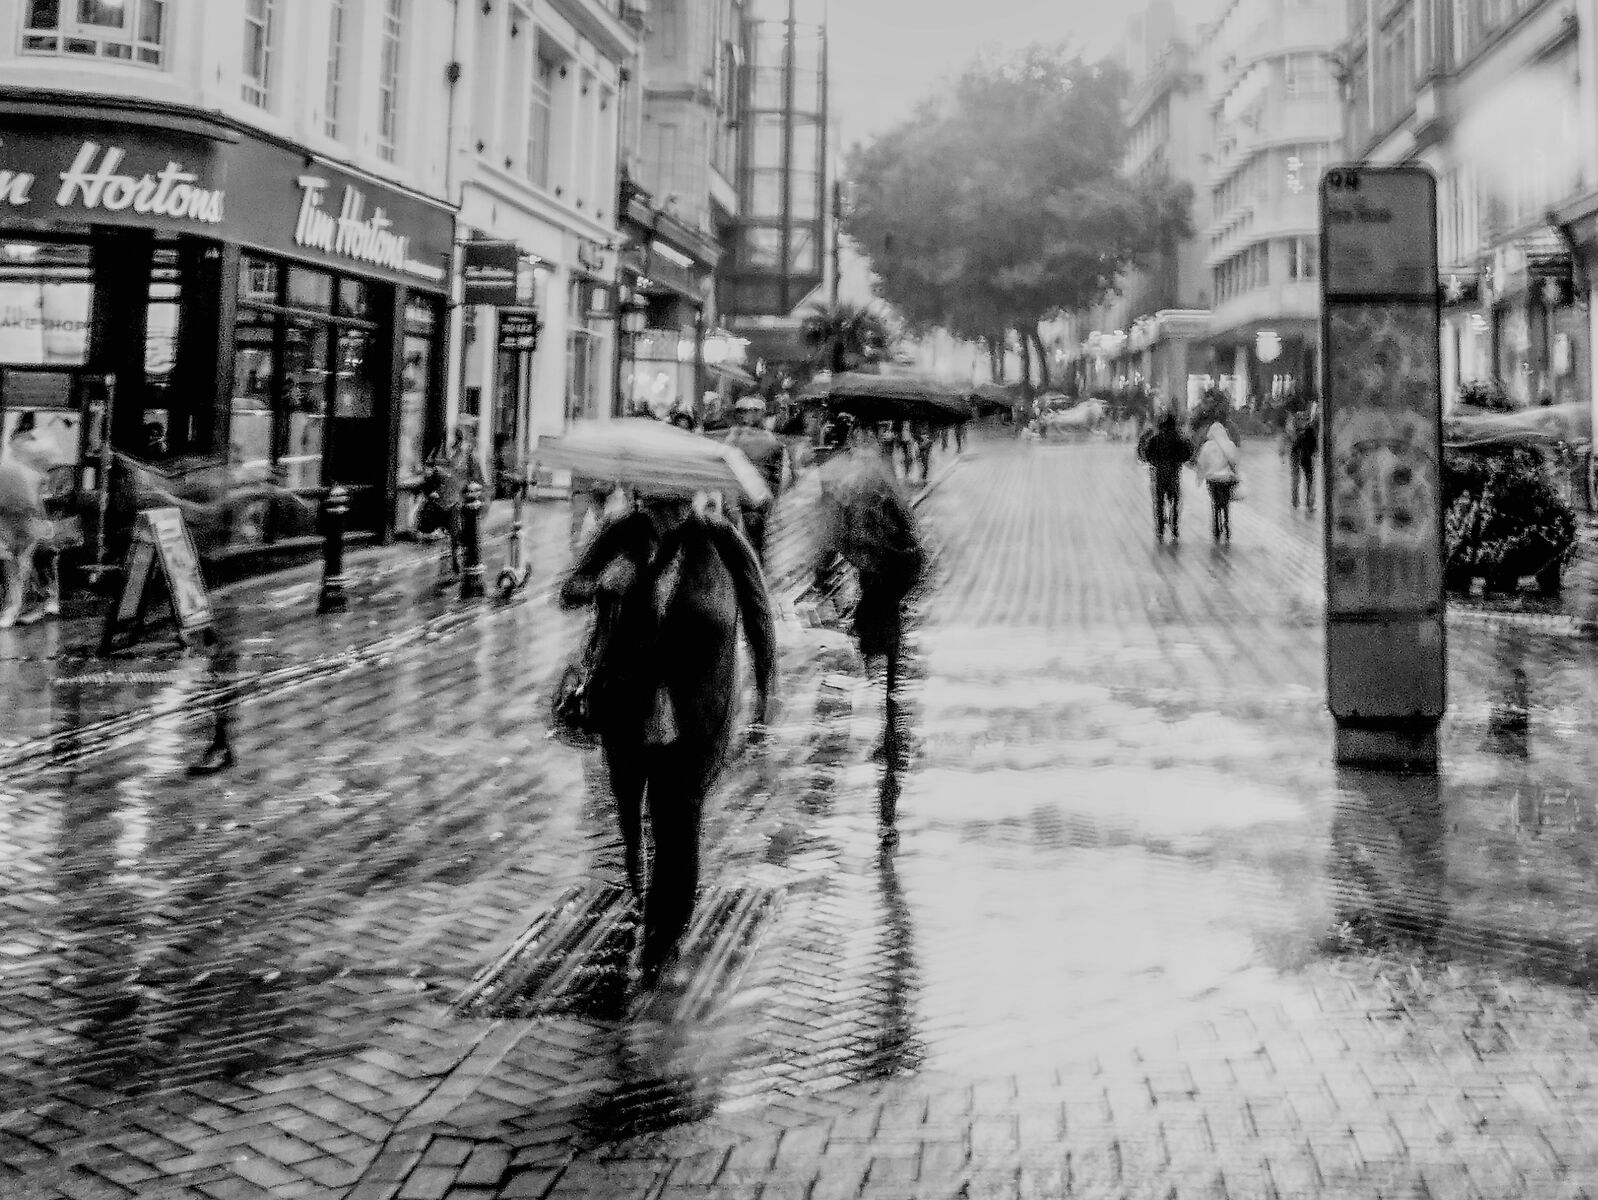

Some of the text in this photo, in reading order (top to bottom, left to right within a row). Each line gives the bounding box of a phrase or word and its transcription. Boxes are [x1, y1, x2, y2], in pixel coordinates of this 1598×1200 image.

[56, 141, 225, 223] Hortons
[295, 175, 412, 270] Tim Hortons
